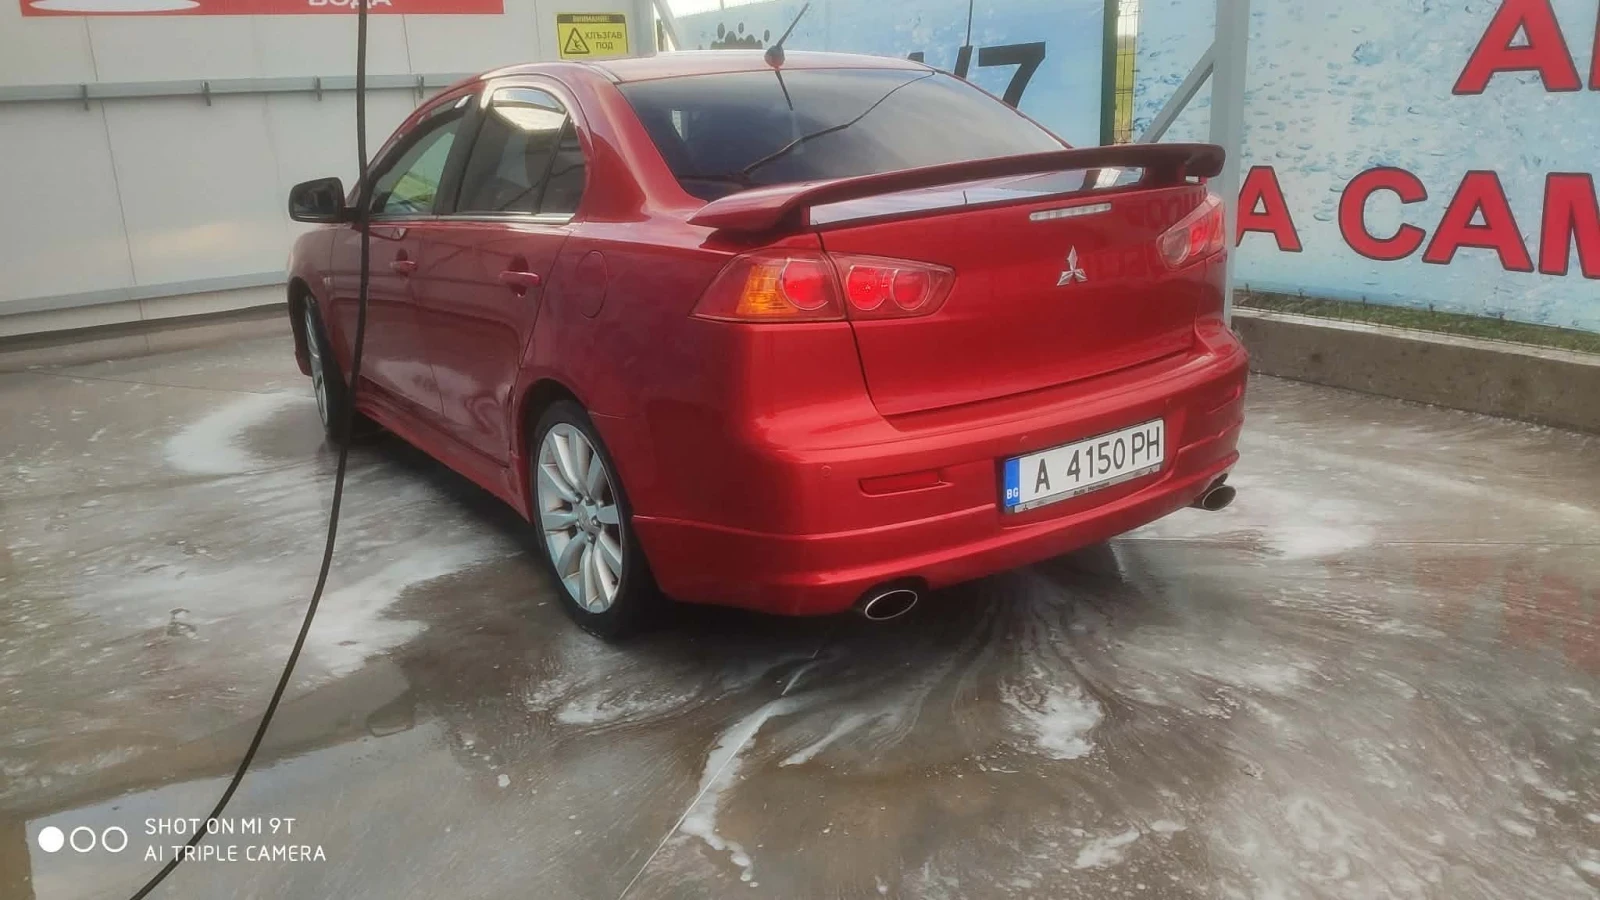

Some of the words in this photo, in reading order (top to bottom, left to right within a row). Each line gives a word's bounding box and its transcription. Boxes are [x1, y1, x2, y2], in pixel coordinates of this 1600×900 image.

[584, 31, 623, 39] ХЛЪЗГАВ
[595, 41, 614, 50] ПОД
[1035, 458, 1051, 493] A
[1066, 437, 1126, 482] 4150
[1131, 426, 1160, 465] PH
[1006, 487, 1019, 500] BG
